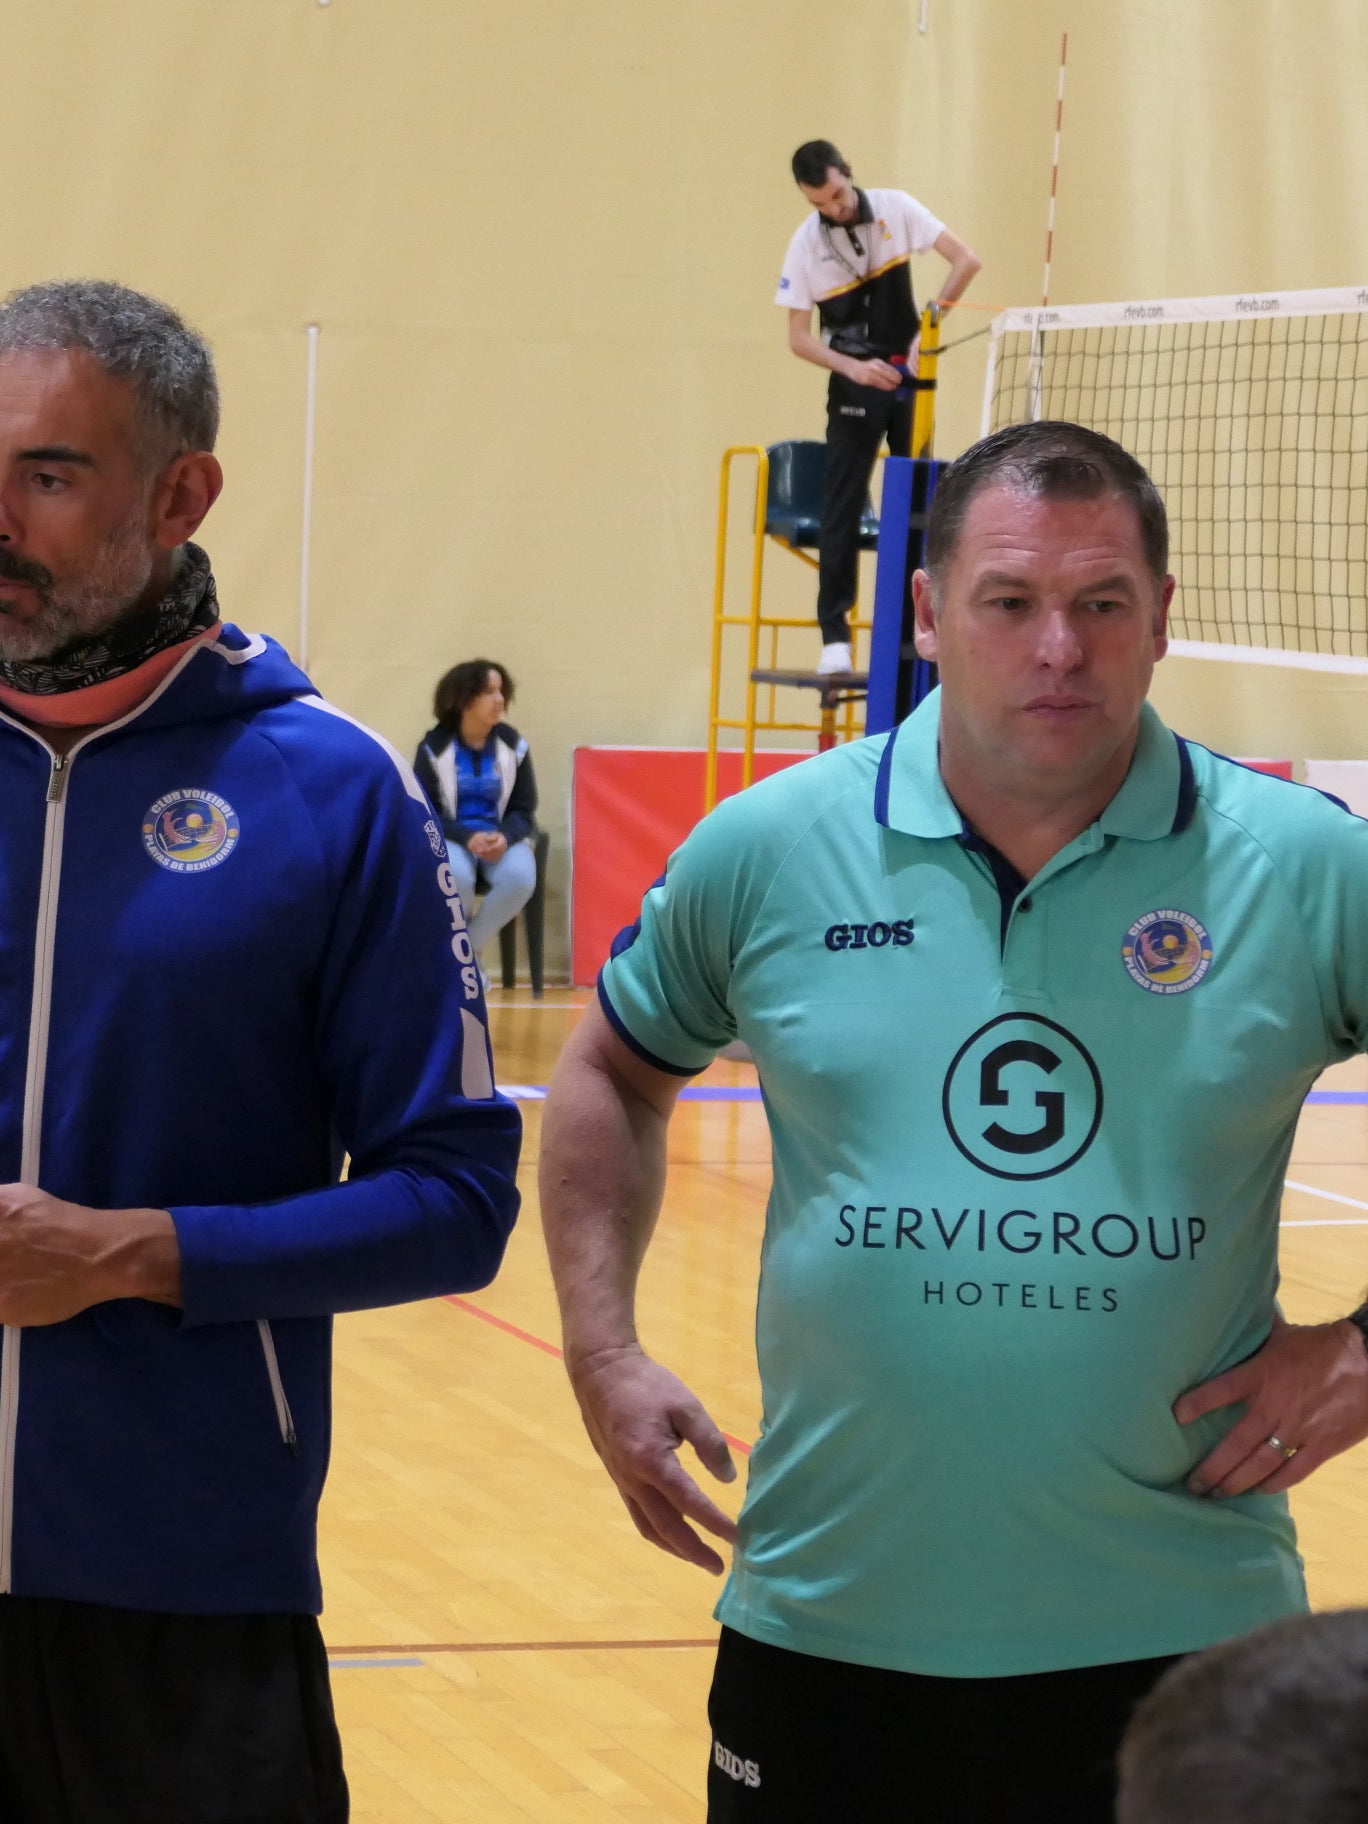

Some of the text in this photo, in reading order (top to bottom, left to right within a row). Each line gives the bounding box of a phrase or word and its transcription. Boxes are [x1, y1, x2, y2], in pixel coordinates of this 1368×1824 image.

[151, 790, 235, 819] CLUB VOLEIBOL
[145, 834, 235, 871] PLAYAS DE BENIDORM
[437, 862, 479, 1000] GIOS
[824, 919, 915, 952] GIOS
[1128, 909, 1207, 939] CLUB VOLEIBOL
[1124, 956, 1151, 988] PLAYAS
[1151, 983, 1166, 993] DE
[835, 1204, 1207, 1260] SERVIGROUP
[923, 1280, 1118, 1312] HOTELES
[714, 1740, 762, 1789] GIOS
